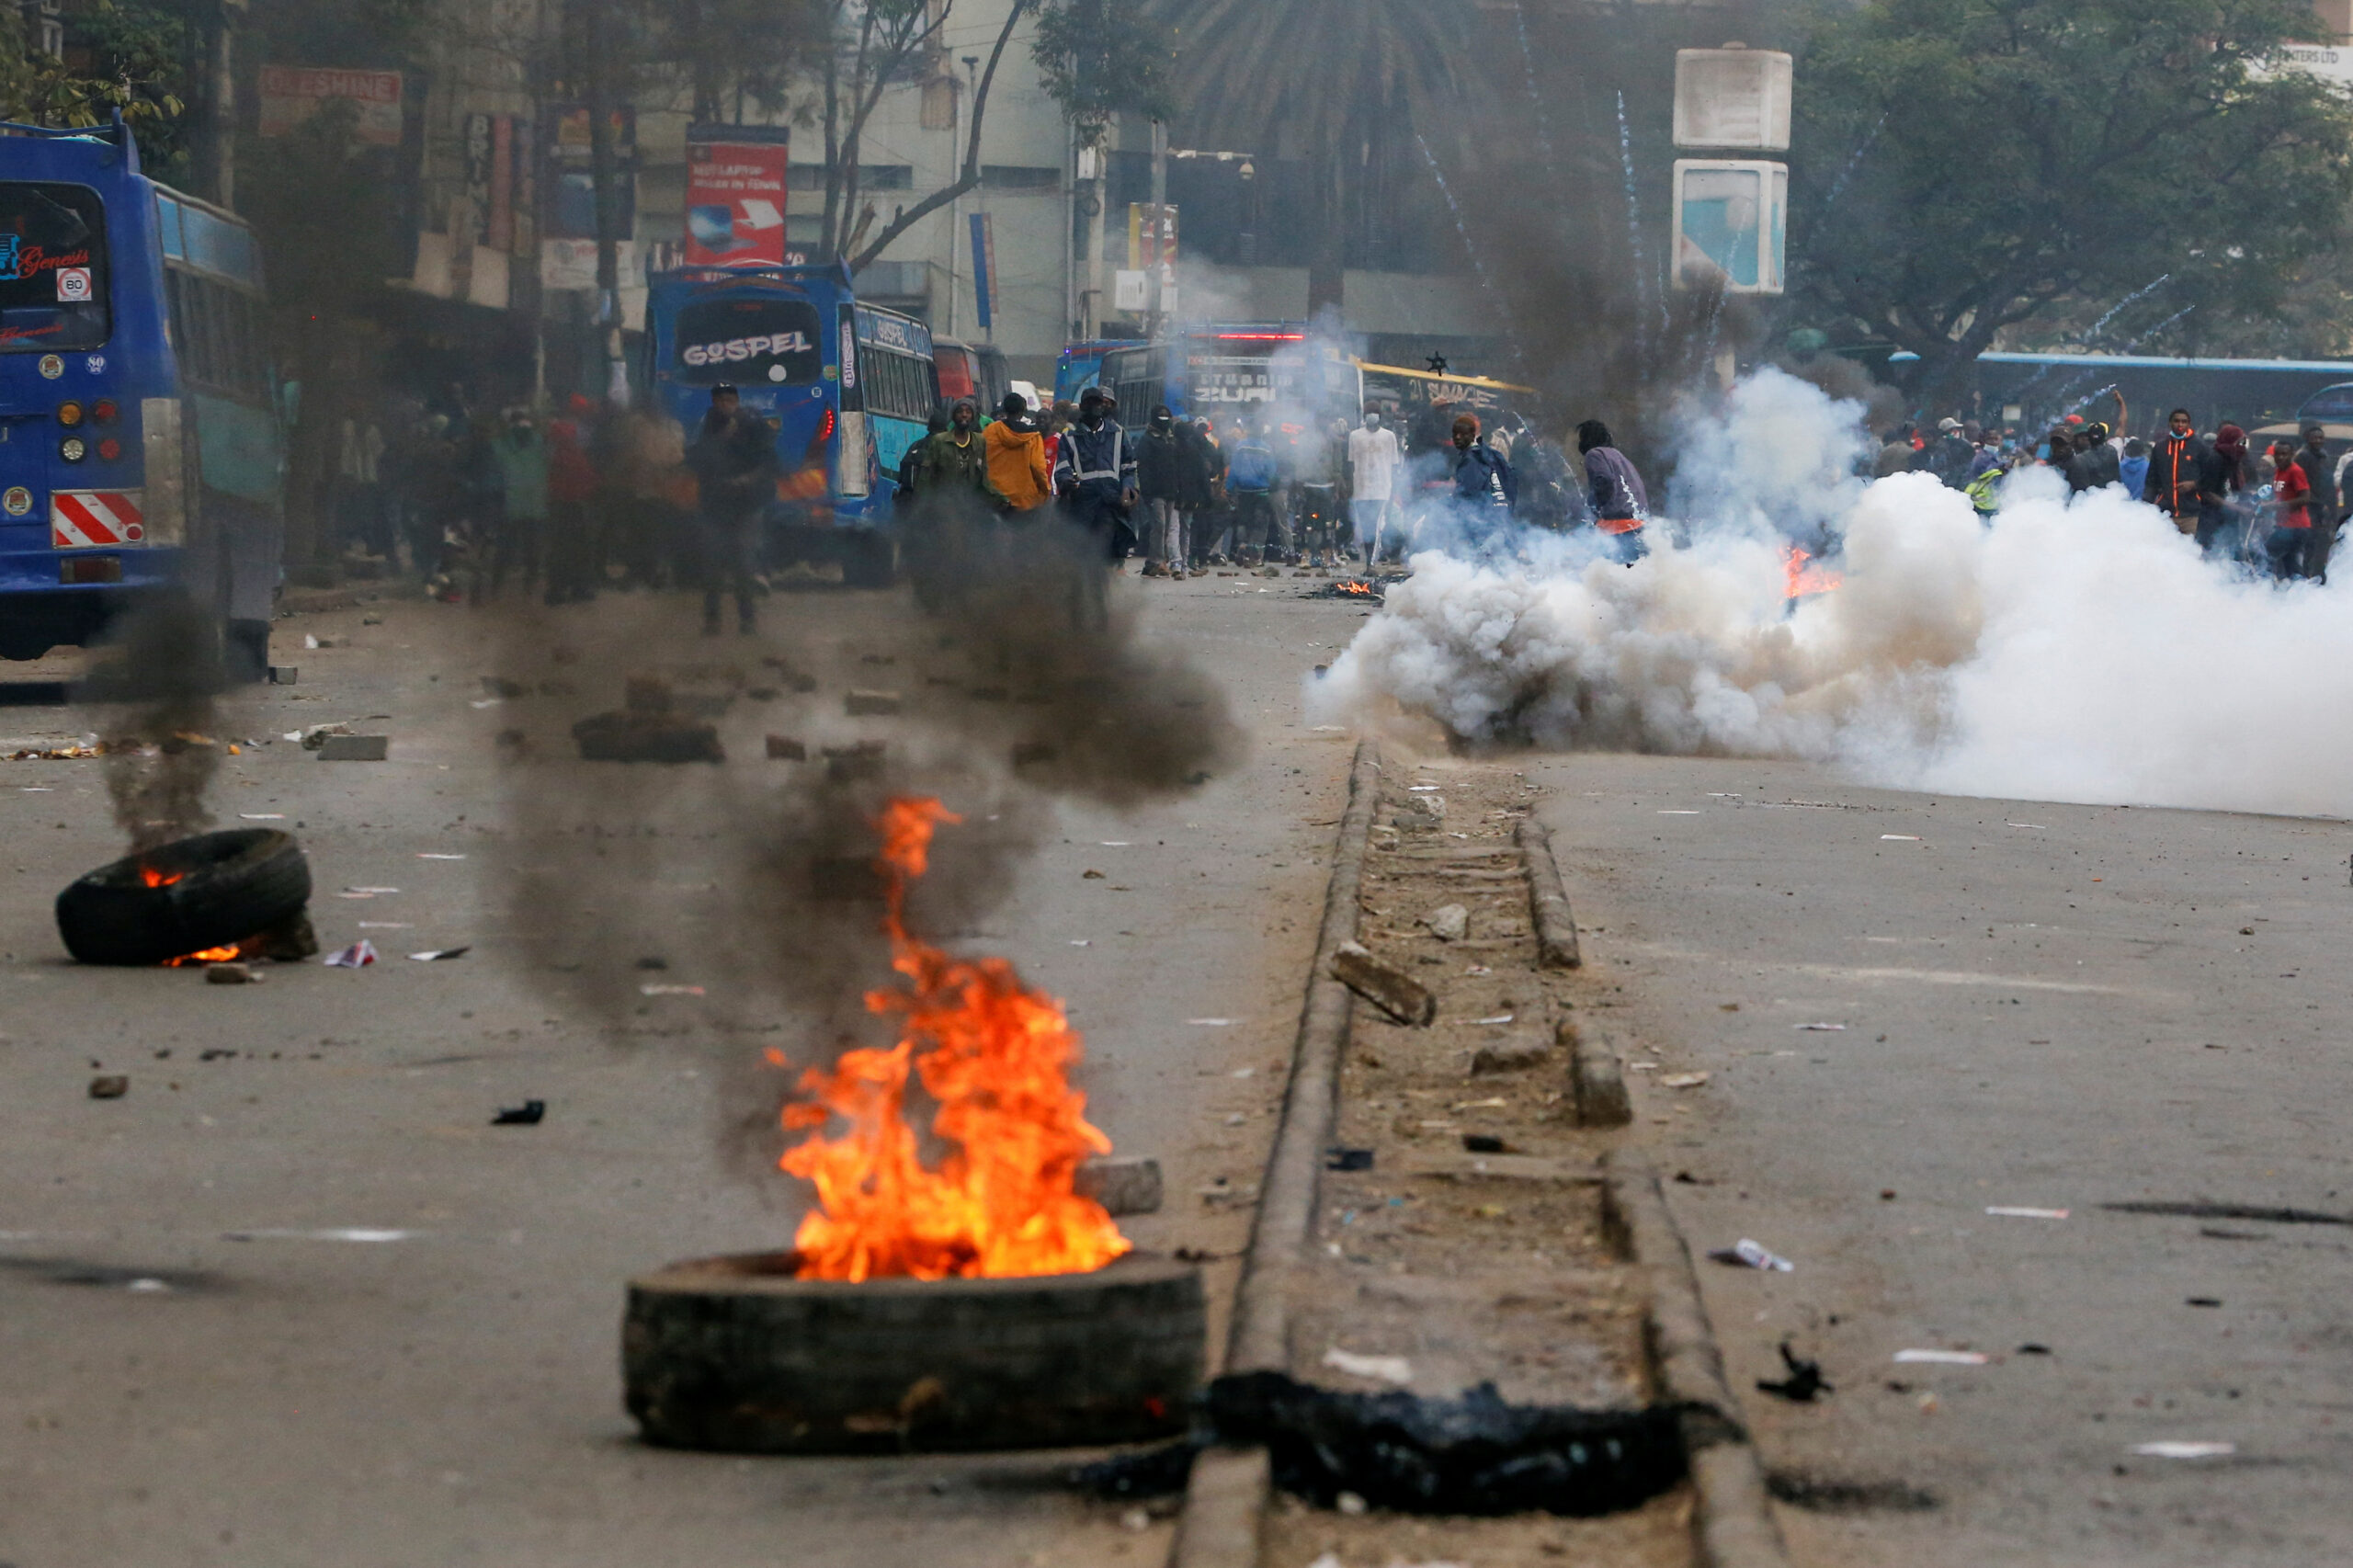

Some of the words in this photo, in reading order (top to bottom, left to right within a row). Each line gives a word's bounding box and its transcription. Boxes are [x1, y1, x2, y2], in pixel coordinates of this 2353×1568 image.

[2322, 51, 2339, 64] LTD
[16, 245, 89, 279] Genesis
[66, 279, 83, 290] 80
[683, 330, 813, 366] GOSPEL
[87, 356, 104, 368] 80
